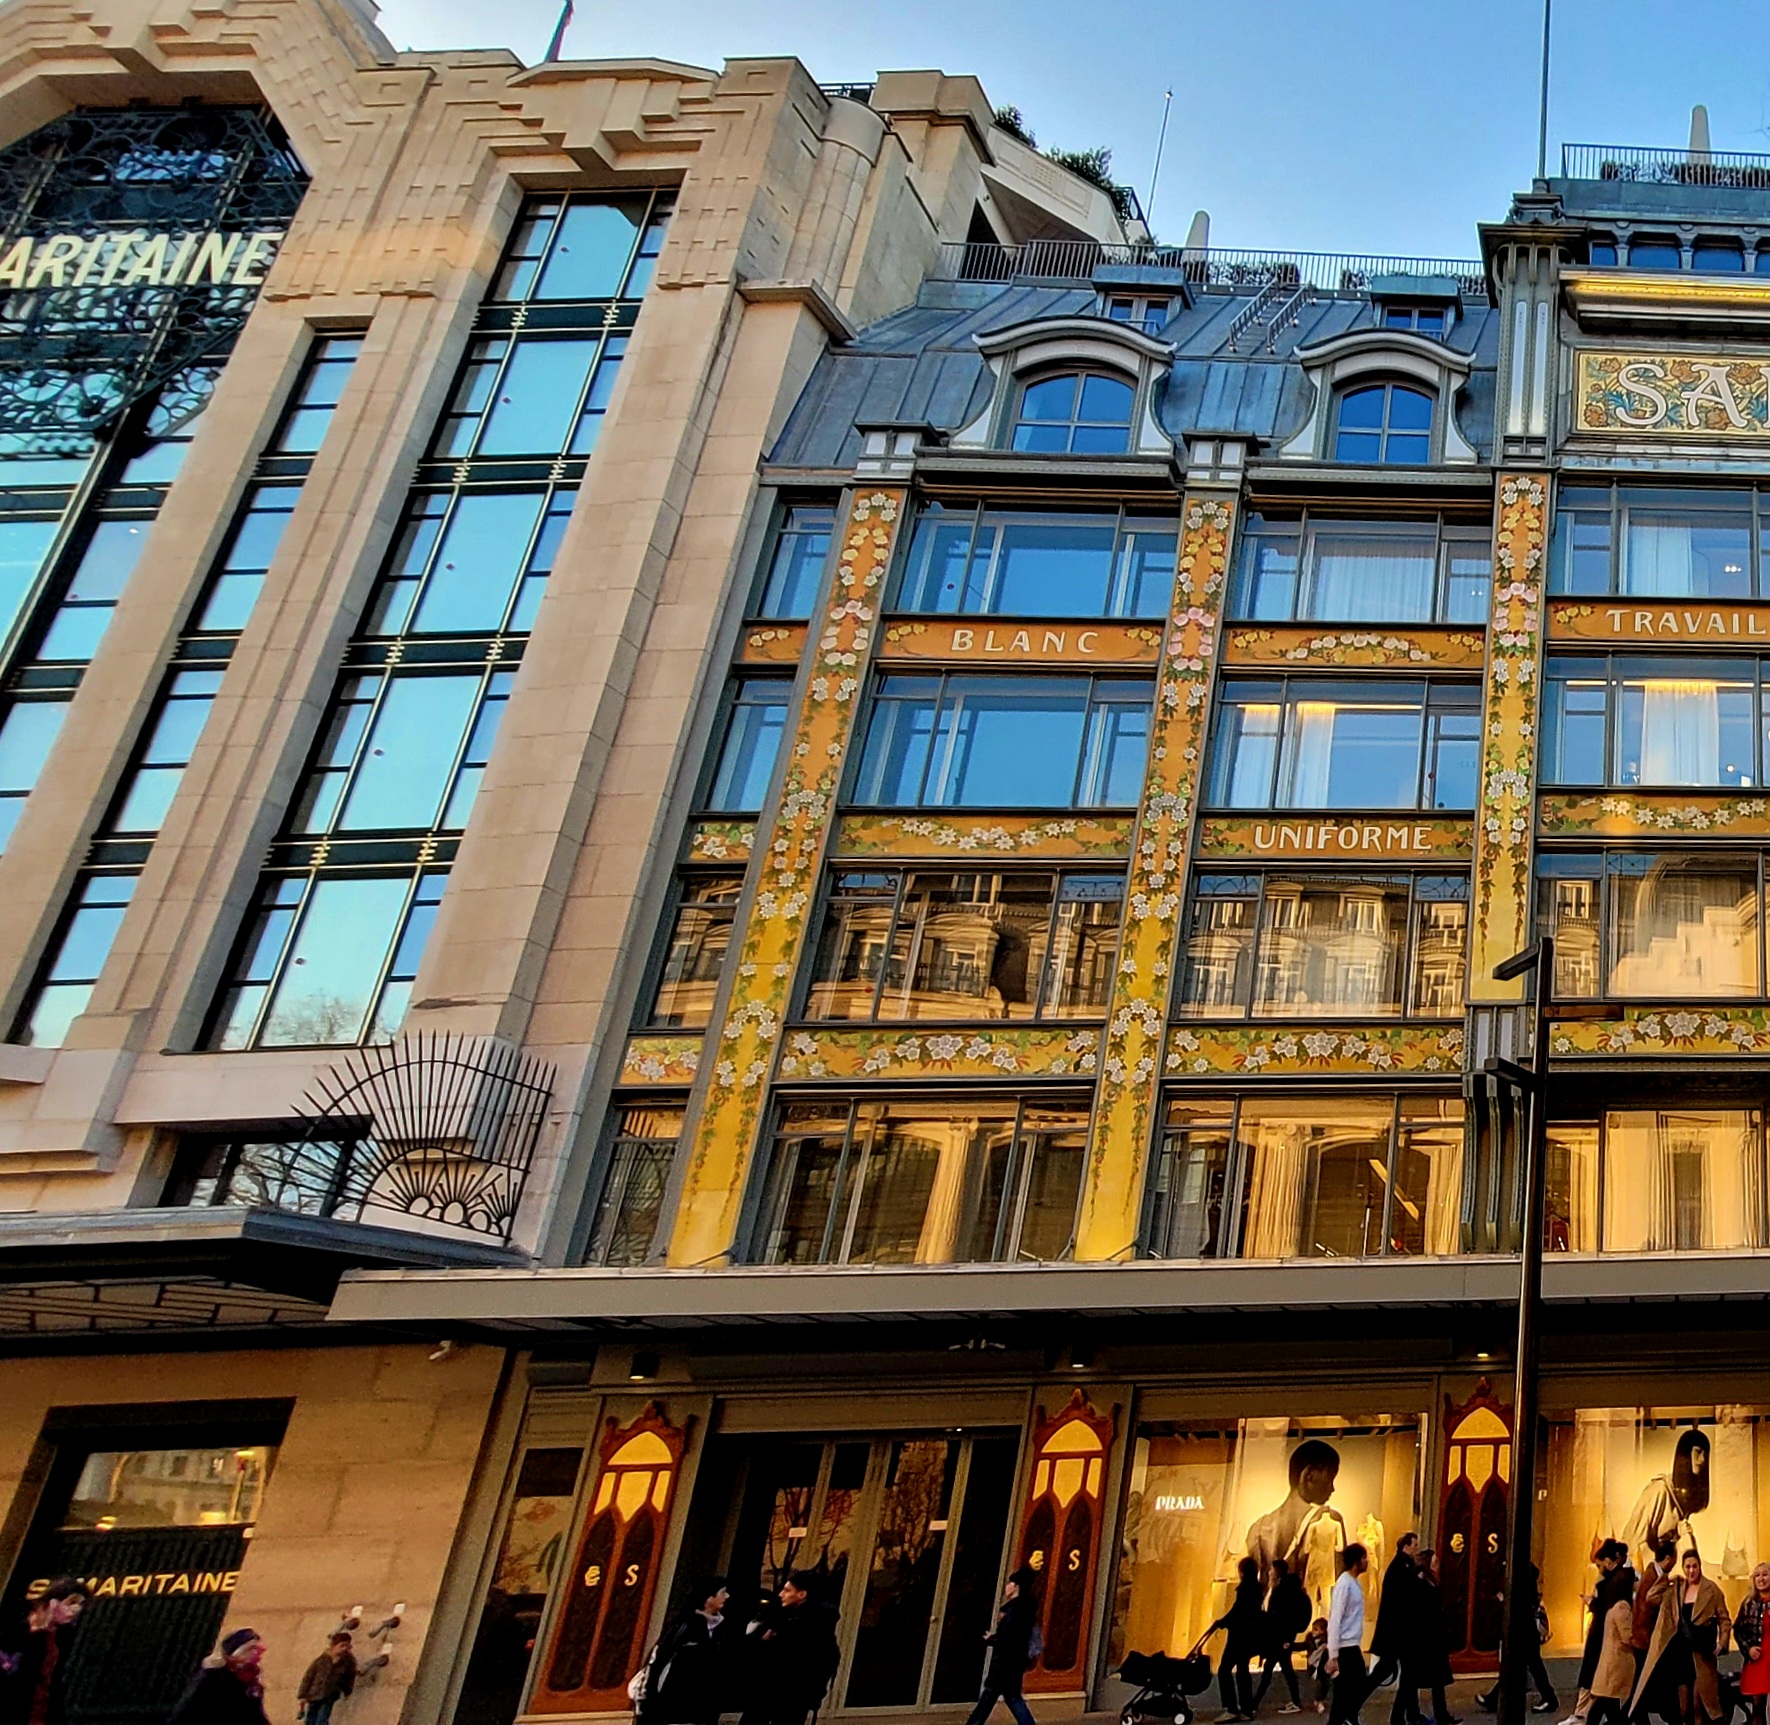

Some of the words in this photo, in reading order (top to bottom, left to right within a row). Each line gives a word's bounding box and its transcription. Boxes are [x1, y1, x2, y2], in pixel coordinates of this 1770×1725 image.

[0, 231, 286, 288] ARITAINE
[1605, 609, 1767, 636] TRAVAIL
[951, 629, 1098, 653] BLANC
[1254, 825, 1432, 852] UNIFORME
[1155, 1495, 1205, 1511] PRADA
